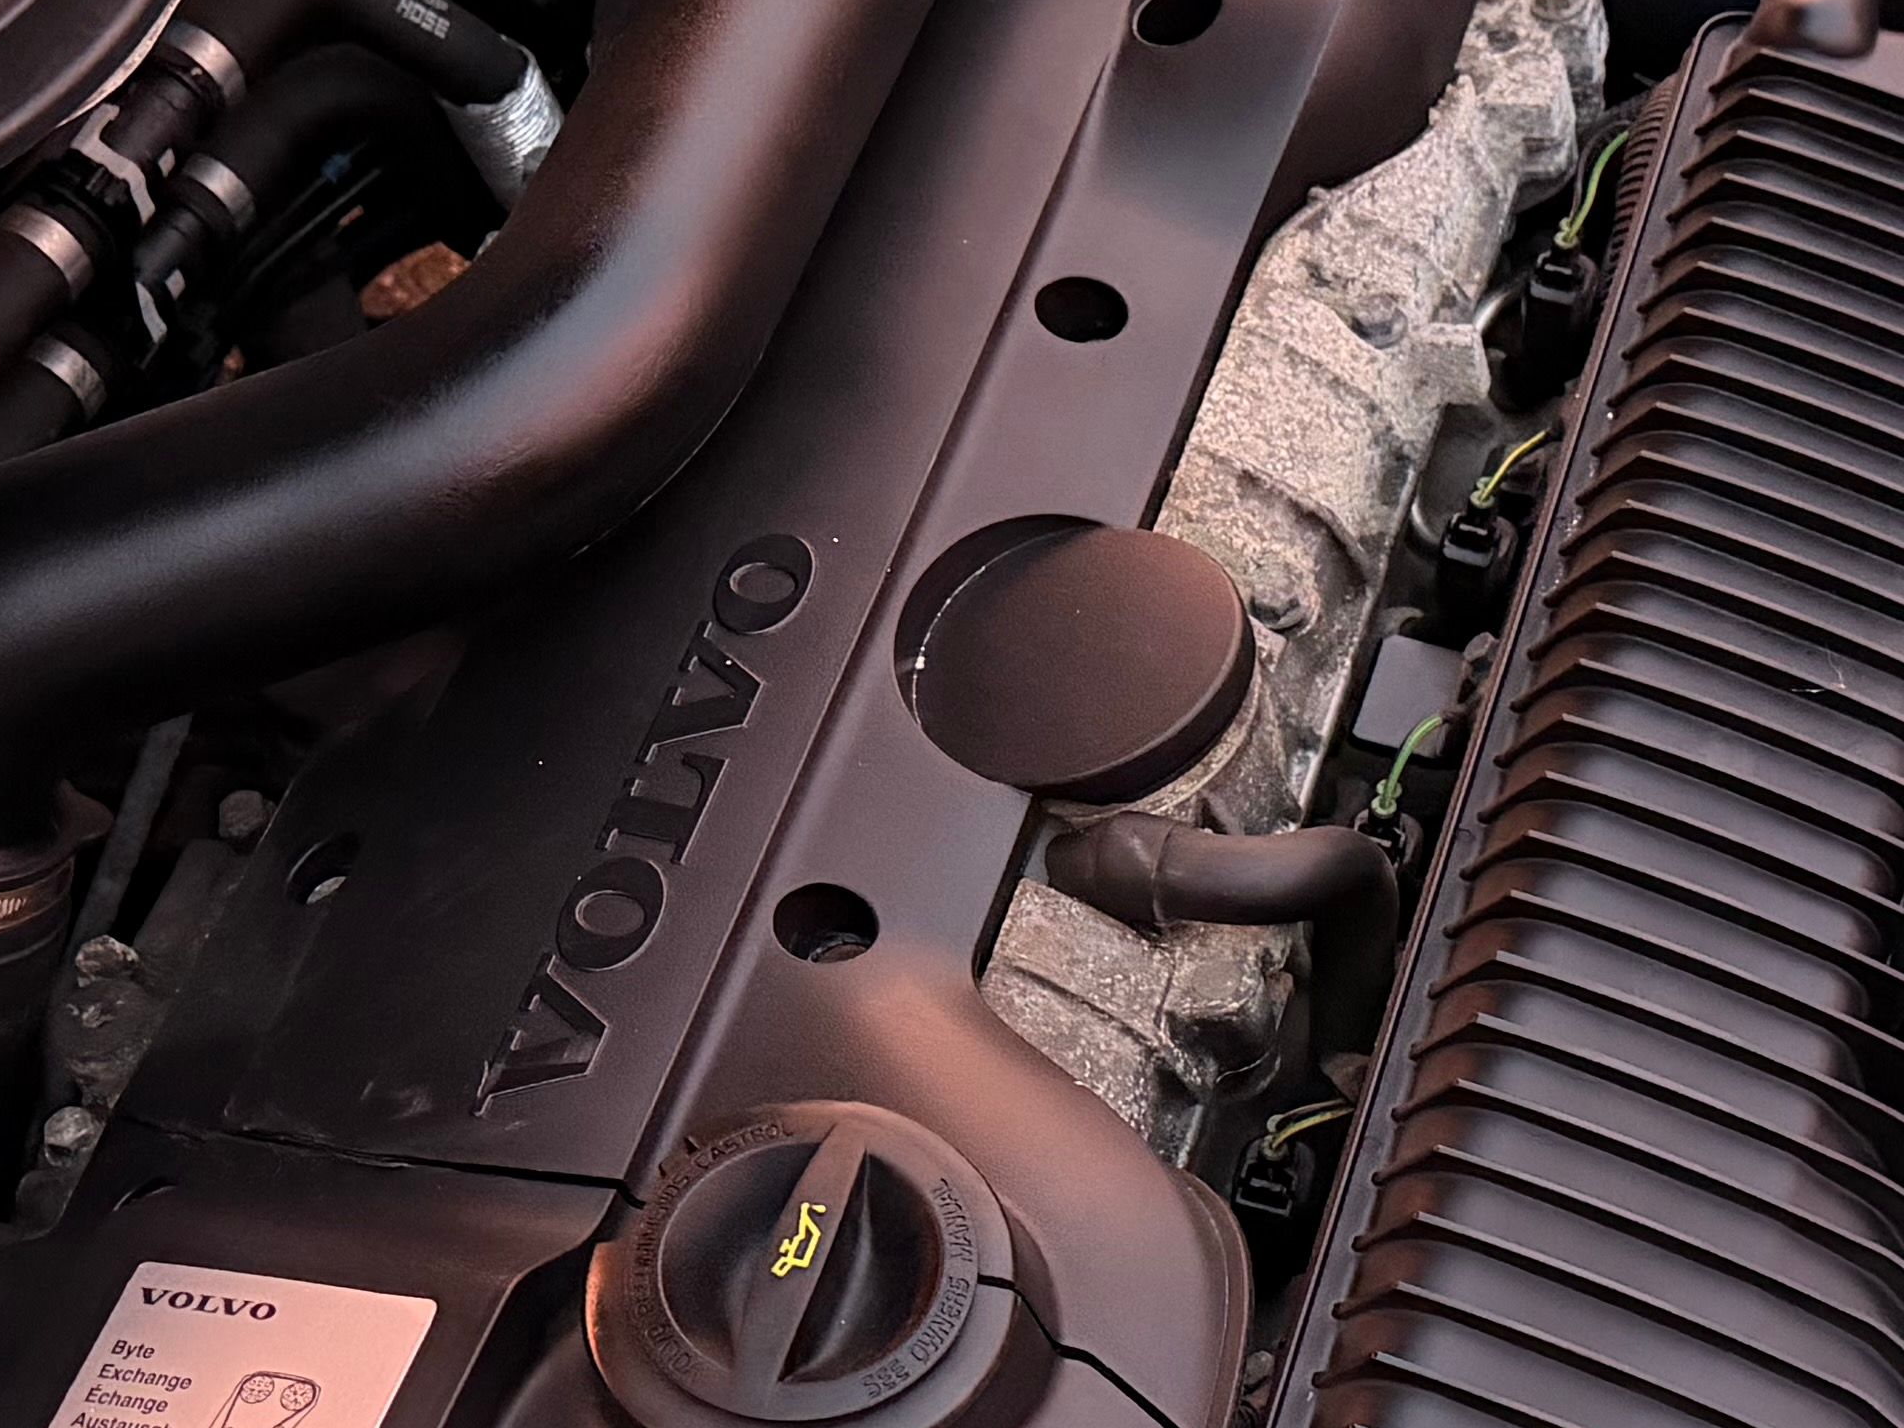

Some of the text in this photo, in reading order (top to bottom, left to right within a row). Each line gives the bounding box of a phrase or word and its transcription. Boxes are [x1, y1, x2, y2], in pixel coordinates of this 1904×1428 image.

[471, 533, 817, 1117] VOLVO
[692, 1121, 794, 1169] CASTROL
[140, 1285, 277, 1321] VOLVO
[860, 1178, 975, 1400] SEE OWNERS MANUAL
[111, 1340, 155, 1359] Byte
[97, 1364, 192, 1391] Exchange
[84, 1383, 168, 1413] Échange
